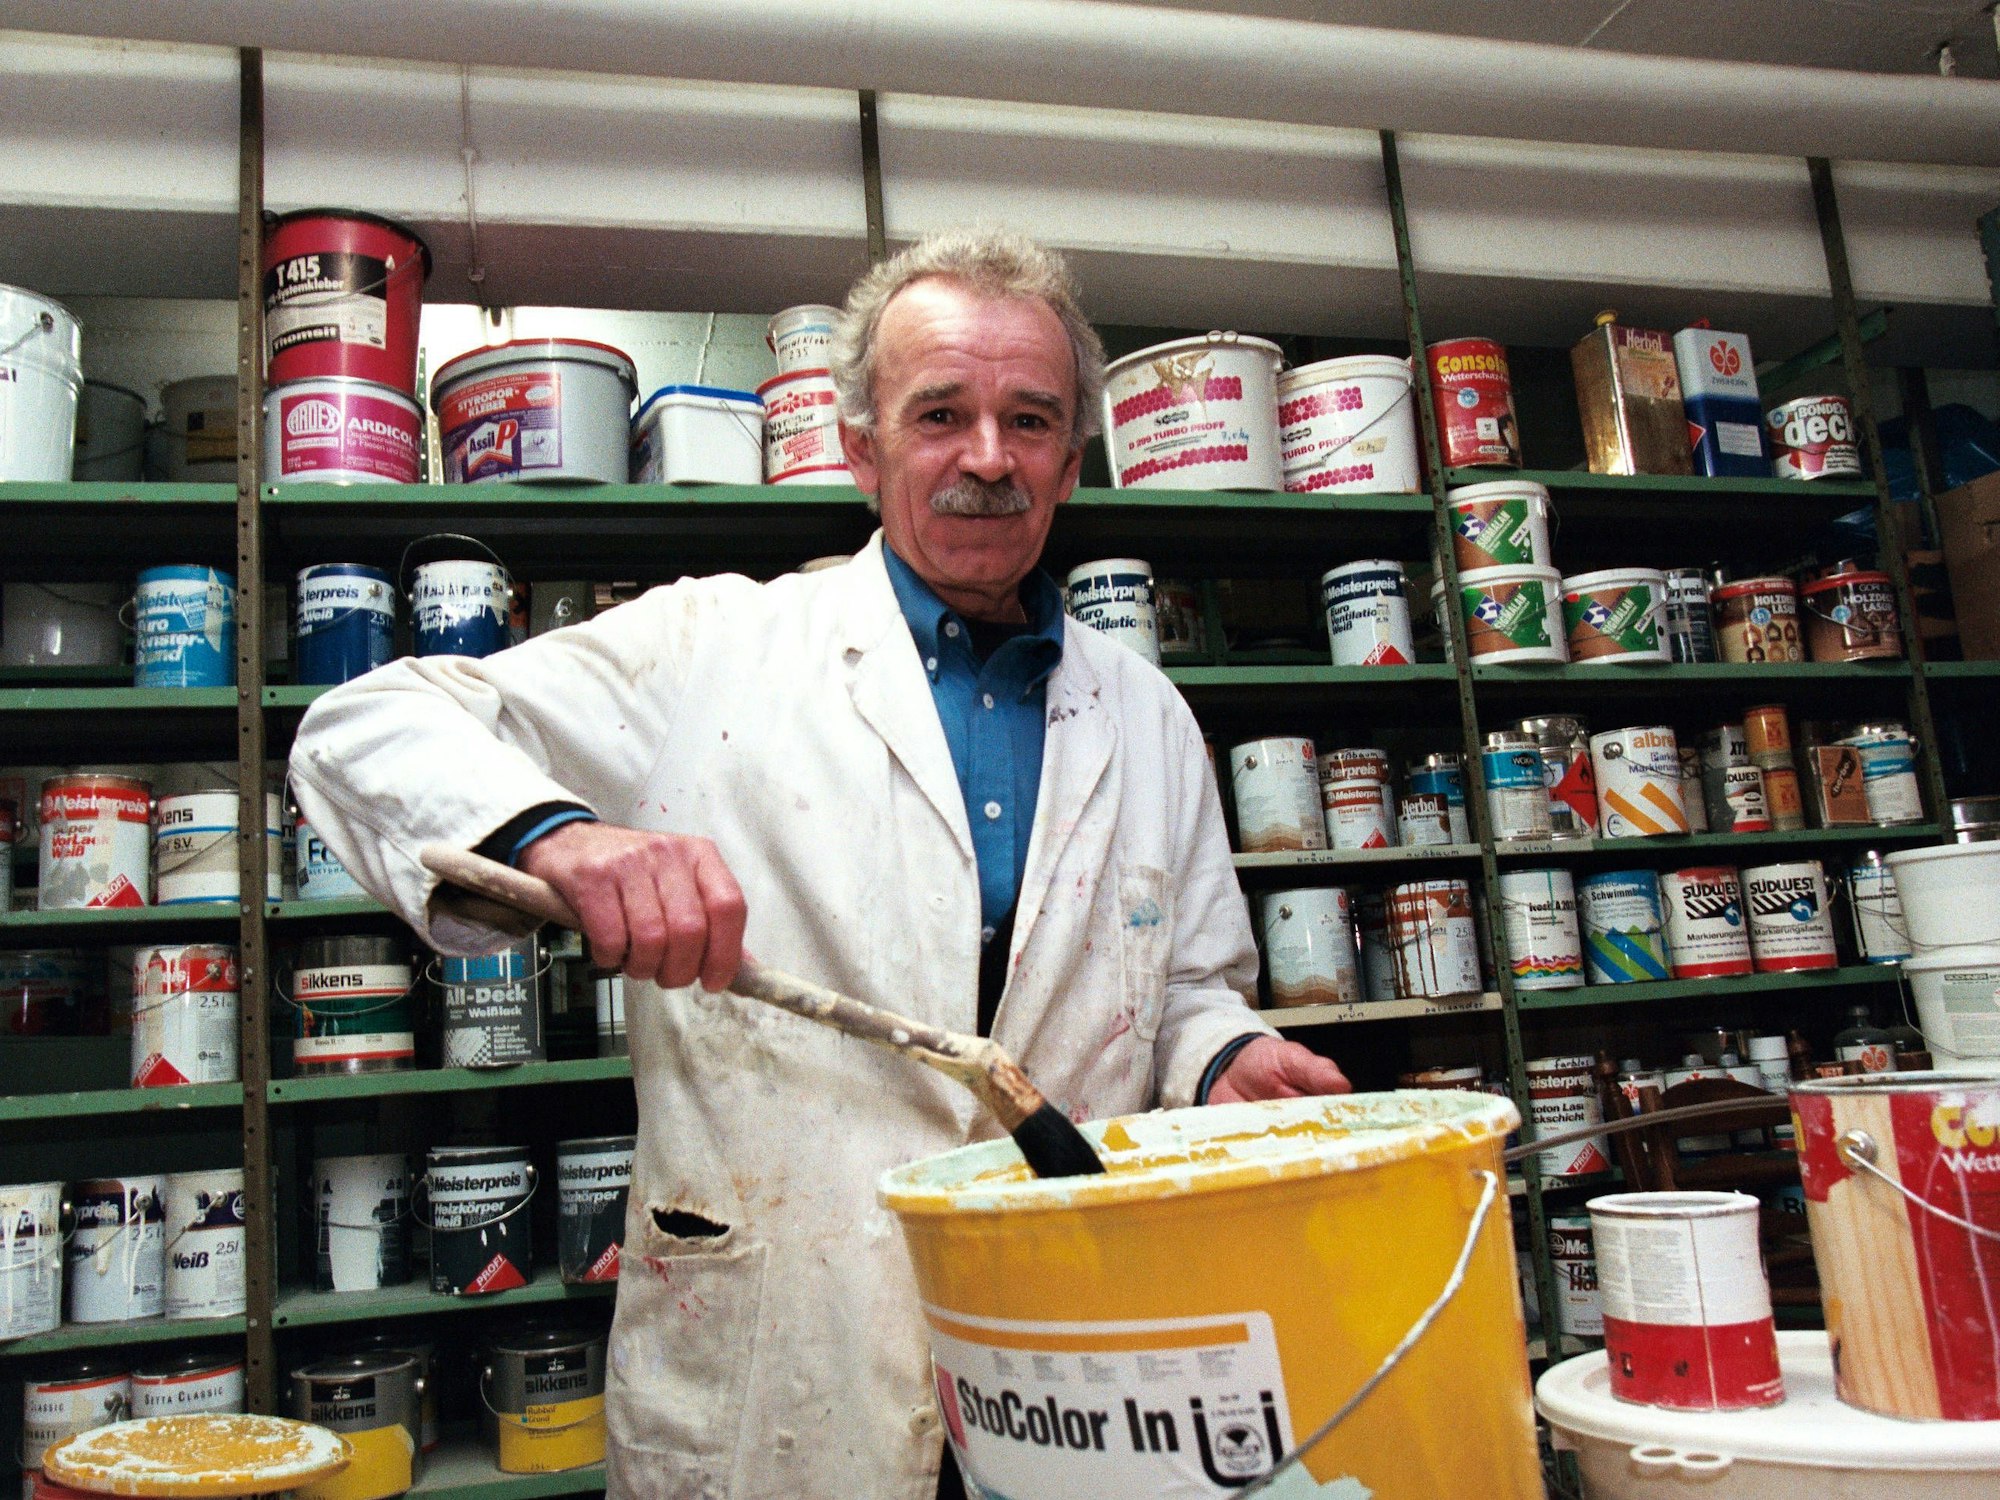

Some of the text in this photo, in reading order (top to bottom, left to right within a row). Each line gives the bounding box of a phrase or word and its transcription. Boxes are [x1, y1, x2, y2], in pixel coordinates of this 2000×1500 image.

[276, 254, 321, 288] T 415
[273, 325, 338, 351] Thomsit
[1625, 328, 1663, 352] Herbol
[1437, 353, 1510, 375] Consola
[286, 400, 341, 436] ARDEX
[467, 399, 507, 418] KLEBER
[347, 416, 414, 447] ARDICOL
[1153, 426, 1189, 441] TURBO
[1190, 421, 1226, 433] PROFF
[469, 430, 496, 454] Assil
[1282, 444, 1316, 462] TURBO
[1476, 509, 1512, 549] SIGMALAN
[1072, 584, 1150, 607] Meisterpris
[1324, 577, 1397, 600] Meisterpreis
[1075, 607, 1104, 622] Euro
[1330, 604, 1350, 617] Euro
[1331, 608, 1378, 626] Ventilatio
[1601, 597, 1636, 634] SIGMALAN
[1332, 622, 1354, 636] Weiß
[55, 795, 147, 814] Meisterpreis
[1401, 796, 1438, 817] Herbol
[159, 807, 194, 825] kens
[173, 837, 194, 850] S.V.
[96, 874, 129, 904] POFI
[1750, 876, 1814, 895] SÜDWEST
[1753, 924, 1824, 937] Markierungsfarbe
[301, 972, 363, 990] sikkens
[1425, 1001, 1484, 1014] palisander
[1532, 1104, 1560, 1114] xoton
[1532, 1111, 1585, 1124] ckschicht
[1930, 1104, 2000, 1149] Co
[434, 1171, 521, 1192] Meisterpreis
[434, 1200, 506, 1217] Heizkörper
[434, 1215, 462, 1228] Weiß
[592, 1242, 620, 1275] PROFI
[475, 1253, 504, 1287] PROFI
[525, 1373, 588, 1394] sikkens
[178, 1386, 224, 1403] CLASSIC
[311, 1403, 376, 1421] sikkens
[957, 1376, 1180, 1453] StoColor In
